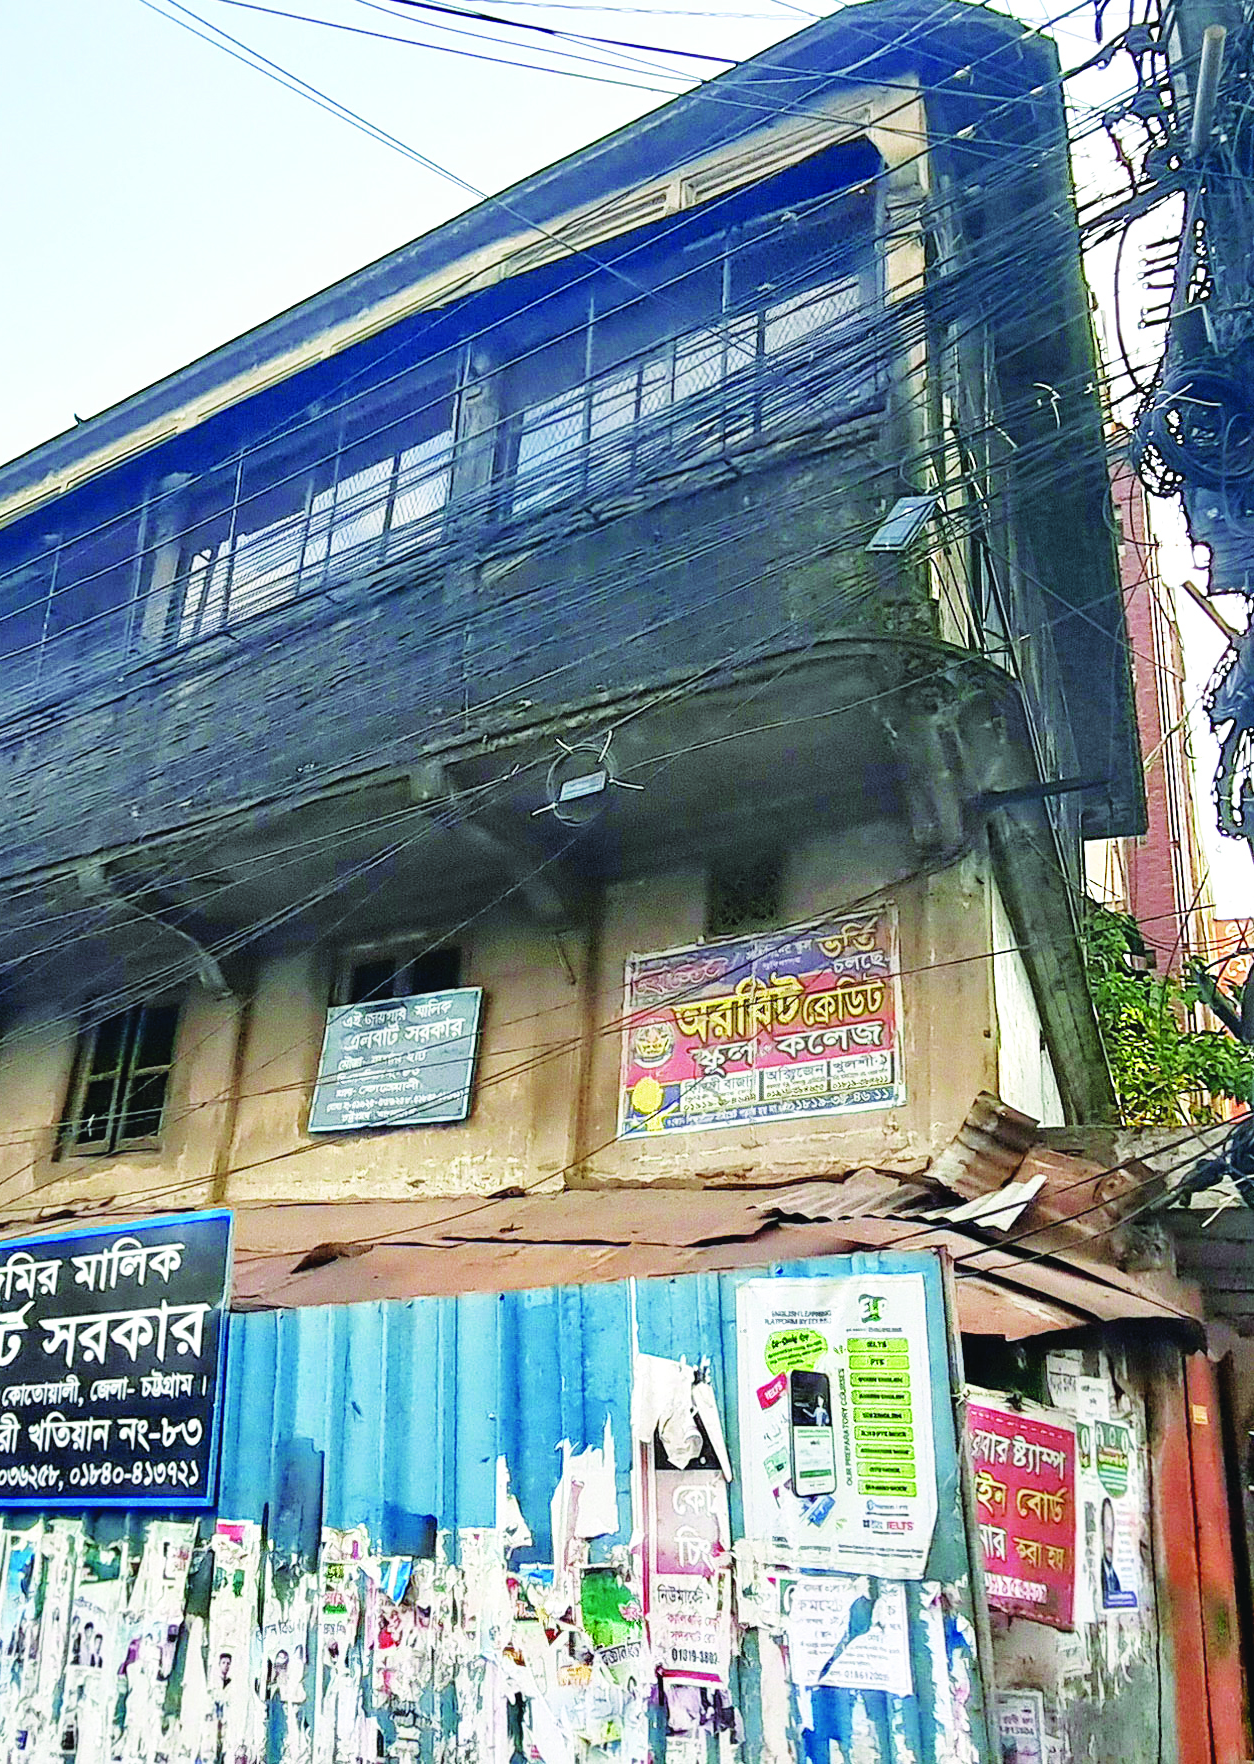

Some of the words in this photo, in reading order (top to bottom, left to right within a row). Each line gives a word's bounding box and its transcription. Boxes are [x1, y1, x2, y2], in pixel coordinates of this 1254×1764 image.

[414, 998, 454, 1018] মালিক
[344, 1022, 399, 1052] এলবার্ট
[405, 1017, 466, 1043] সরকার
[776, 1020, 884, 1059] কলেজ
[71, 1237, 185, 1292] মালিক
[39, 1299, 212, 1368] সরকার
[28, 1411, 113, 1452] খতিয়ান
[69, 1460, 199, 1488] ০১৮৪০-৪১৩৭২১
[1017, 1487, 1068, 1524] বোর্ড
[887, 1521, 914, 1531] IELTS
[1012, 1536, 1042, 1569] করা
